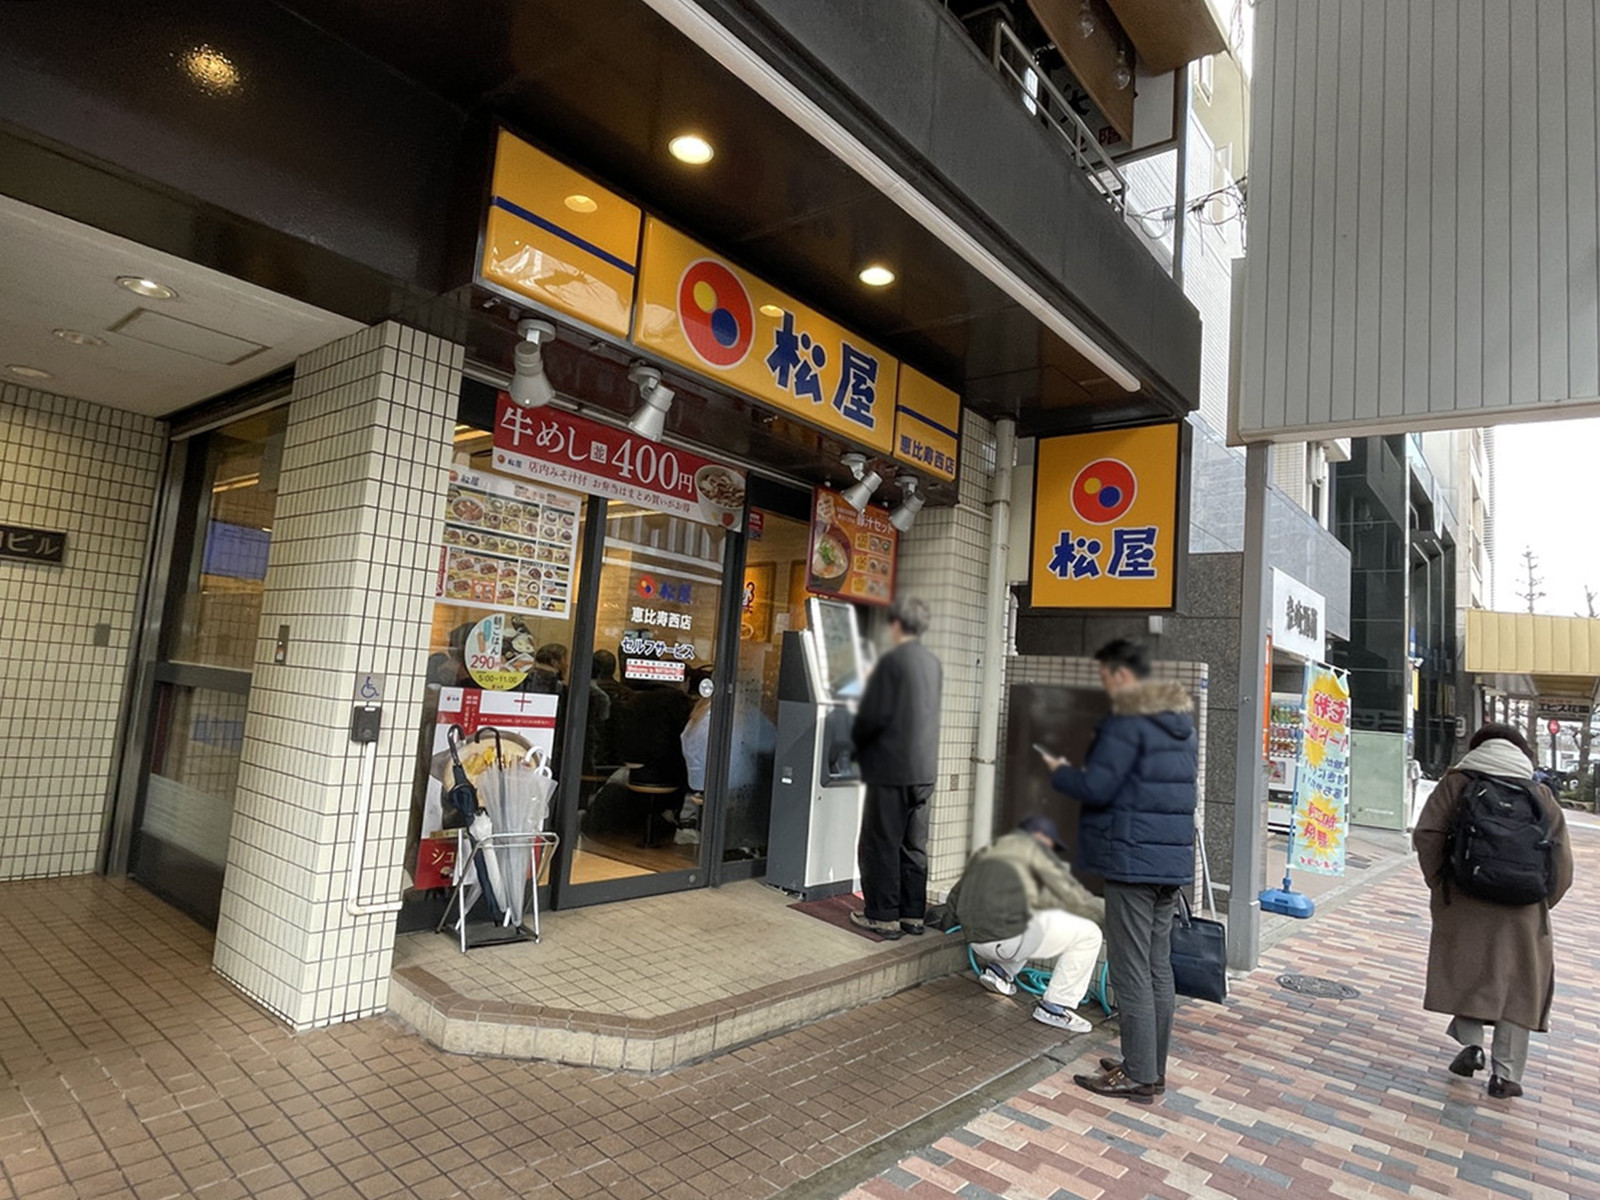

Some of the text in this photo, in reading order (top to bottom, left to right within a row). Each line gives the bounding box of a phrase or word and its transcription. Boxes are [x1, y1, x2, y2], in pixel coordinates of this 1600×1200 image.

[765, 309, 880, 431] 松屋
[528, 461, 587, 487] 店内みそ汁付
[1046, 526, 1159, 580] 松屋
[659, 580, 692, 605] 松屋
[630, 606, 692, 631] 恵比寿西店
[621, 636, 696, 660] セルフサービス
